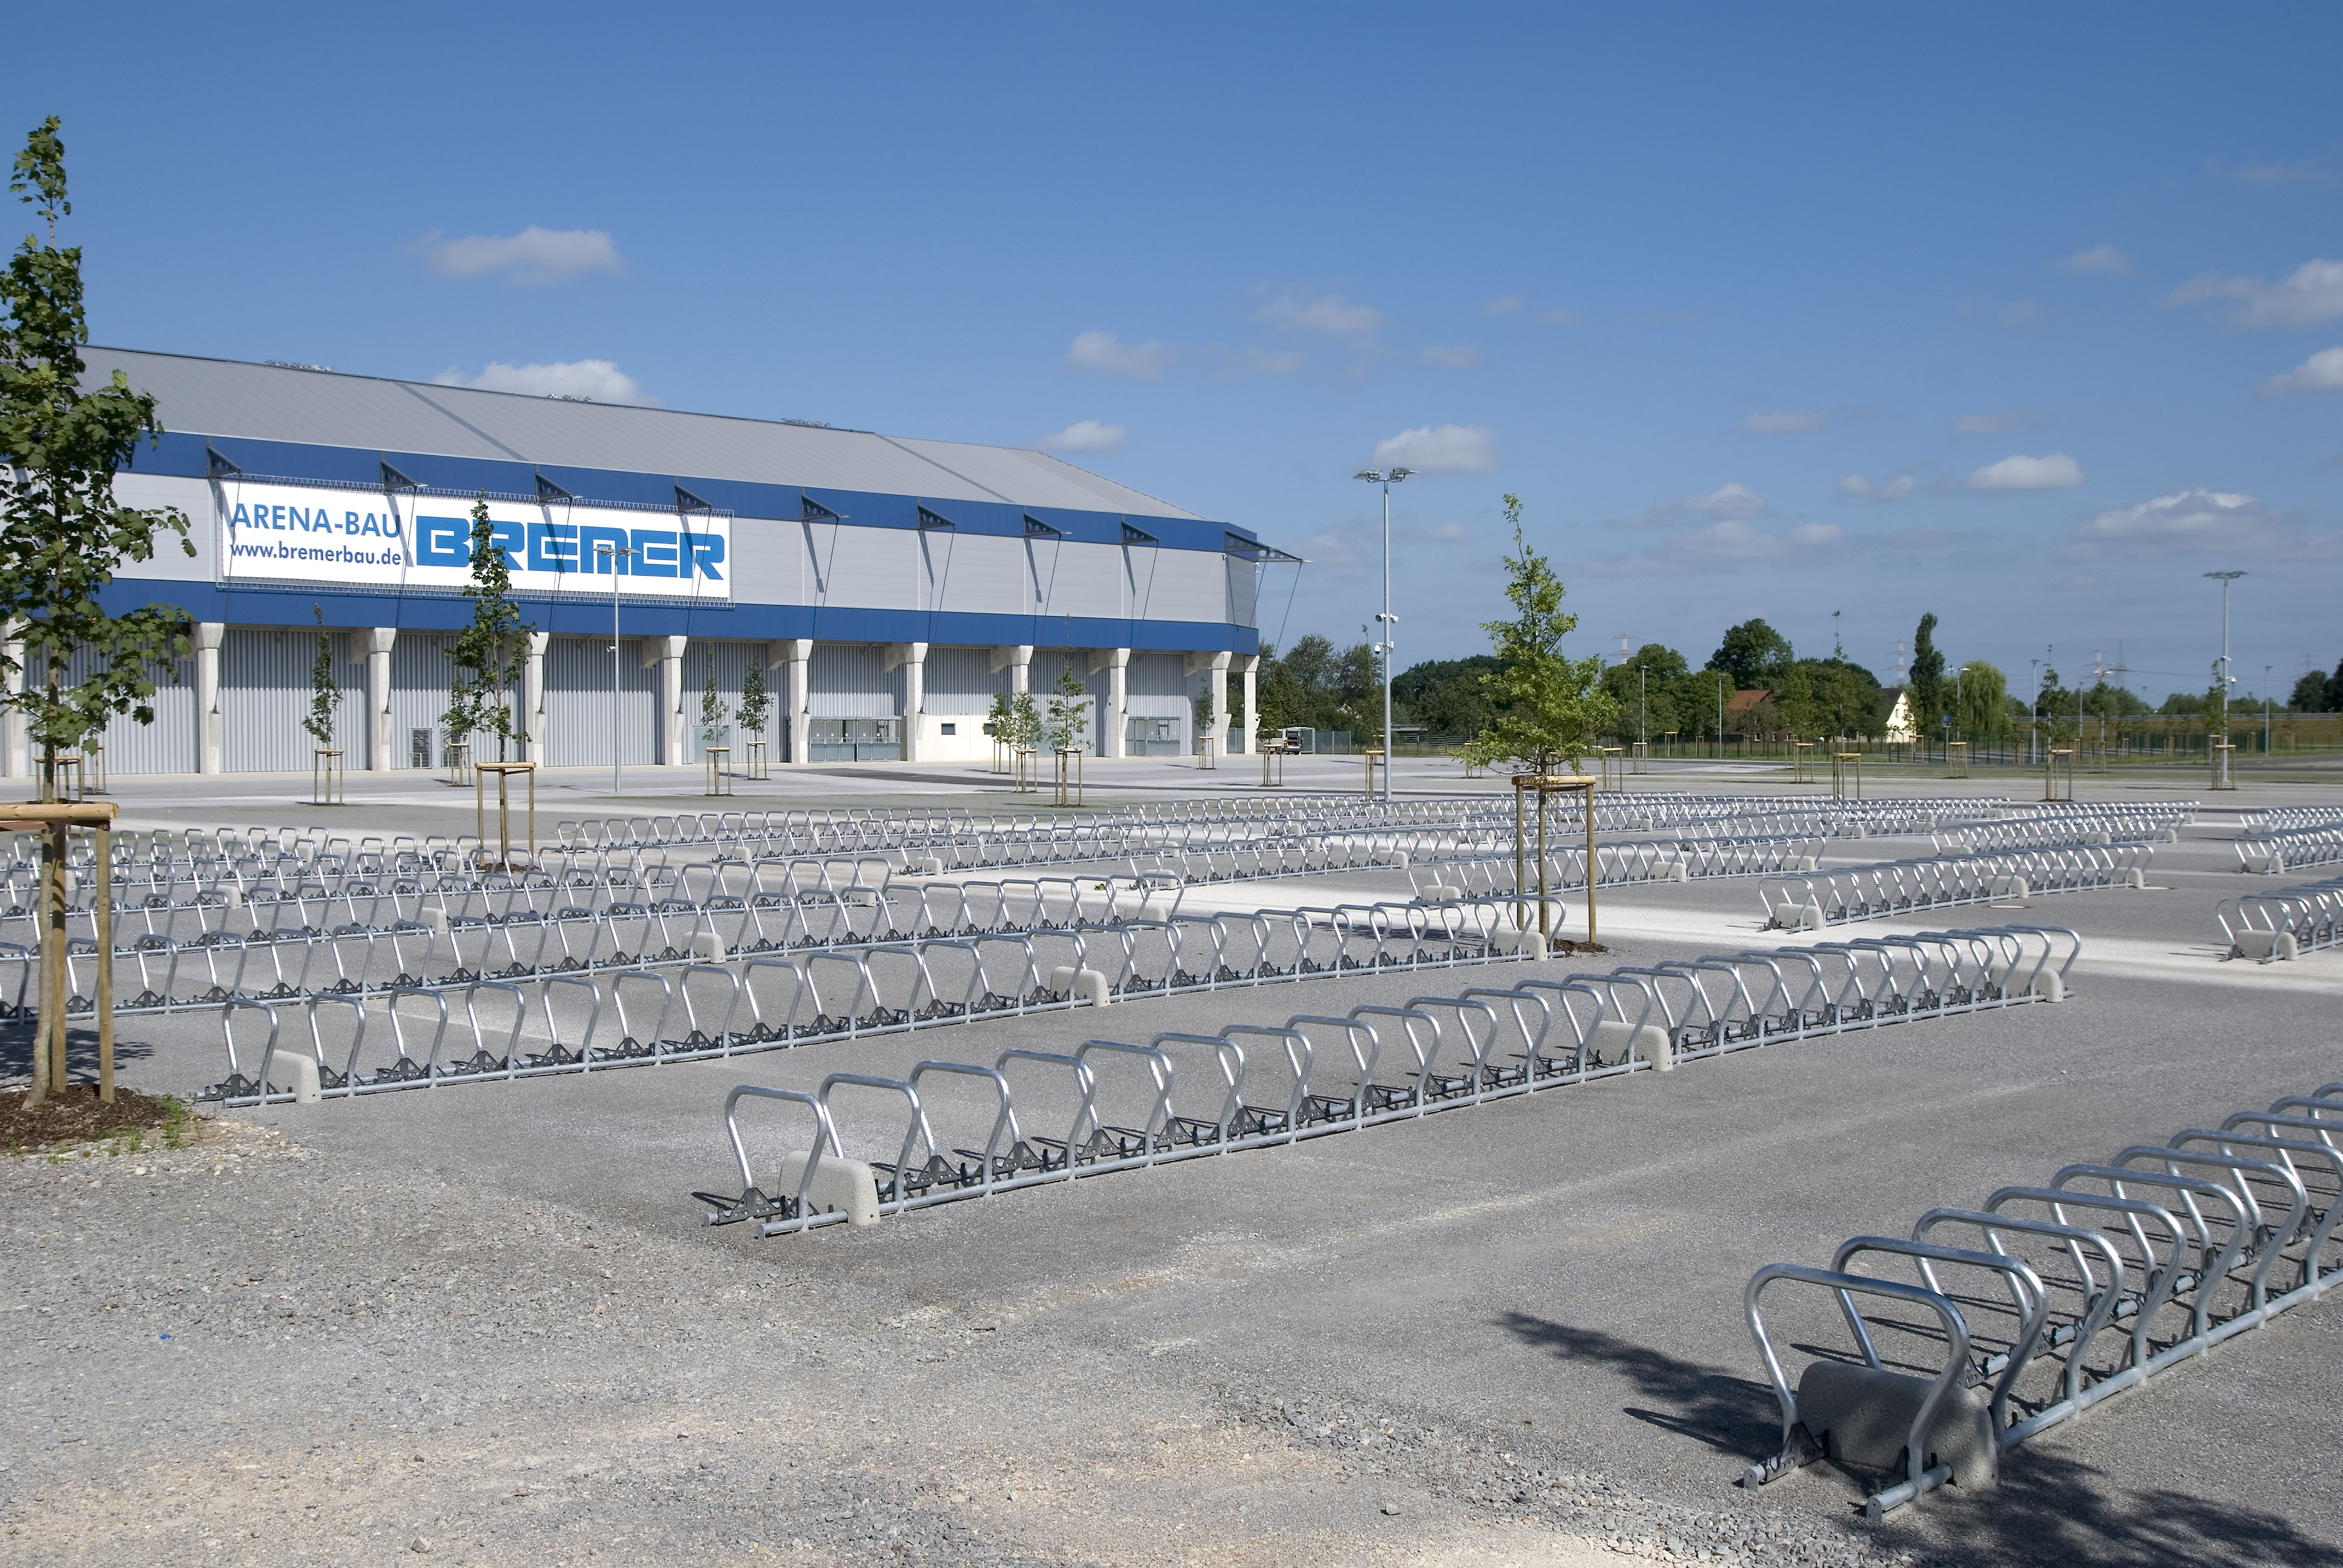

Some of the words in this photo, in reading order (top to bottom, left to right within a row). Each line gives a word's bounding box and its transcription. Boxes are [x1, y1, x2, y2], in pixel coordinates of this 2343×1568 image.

[231, 503, 400, 538] ARENA-BAU
[230, 541, 401, 565] www.bremerbau.de
[416, 515, 725, 580] BREMER
